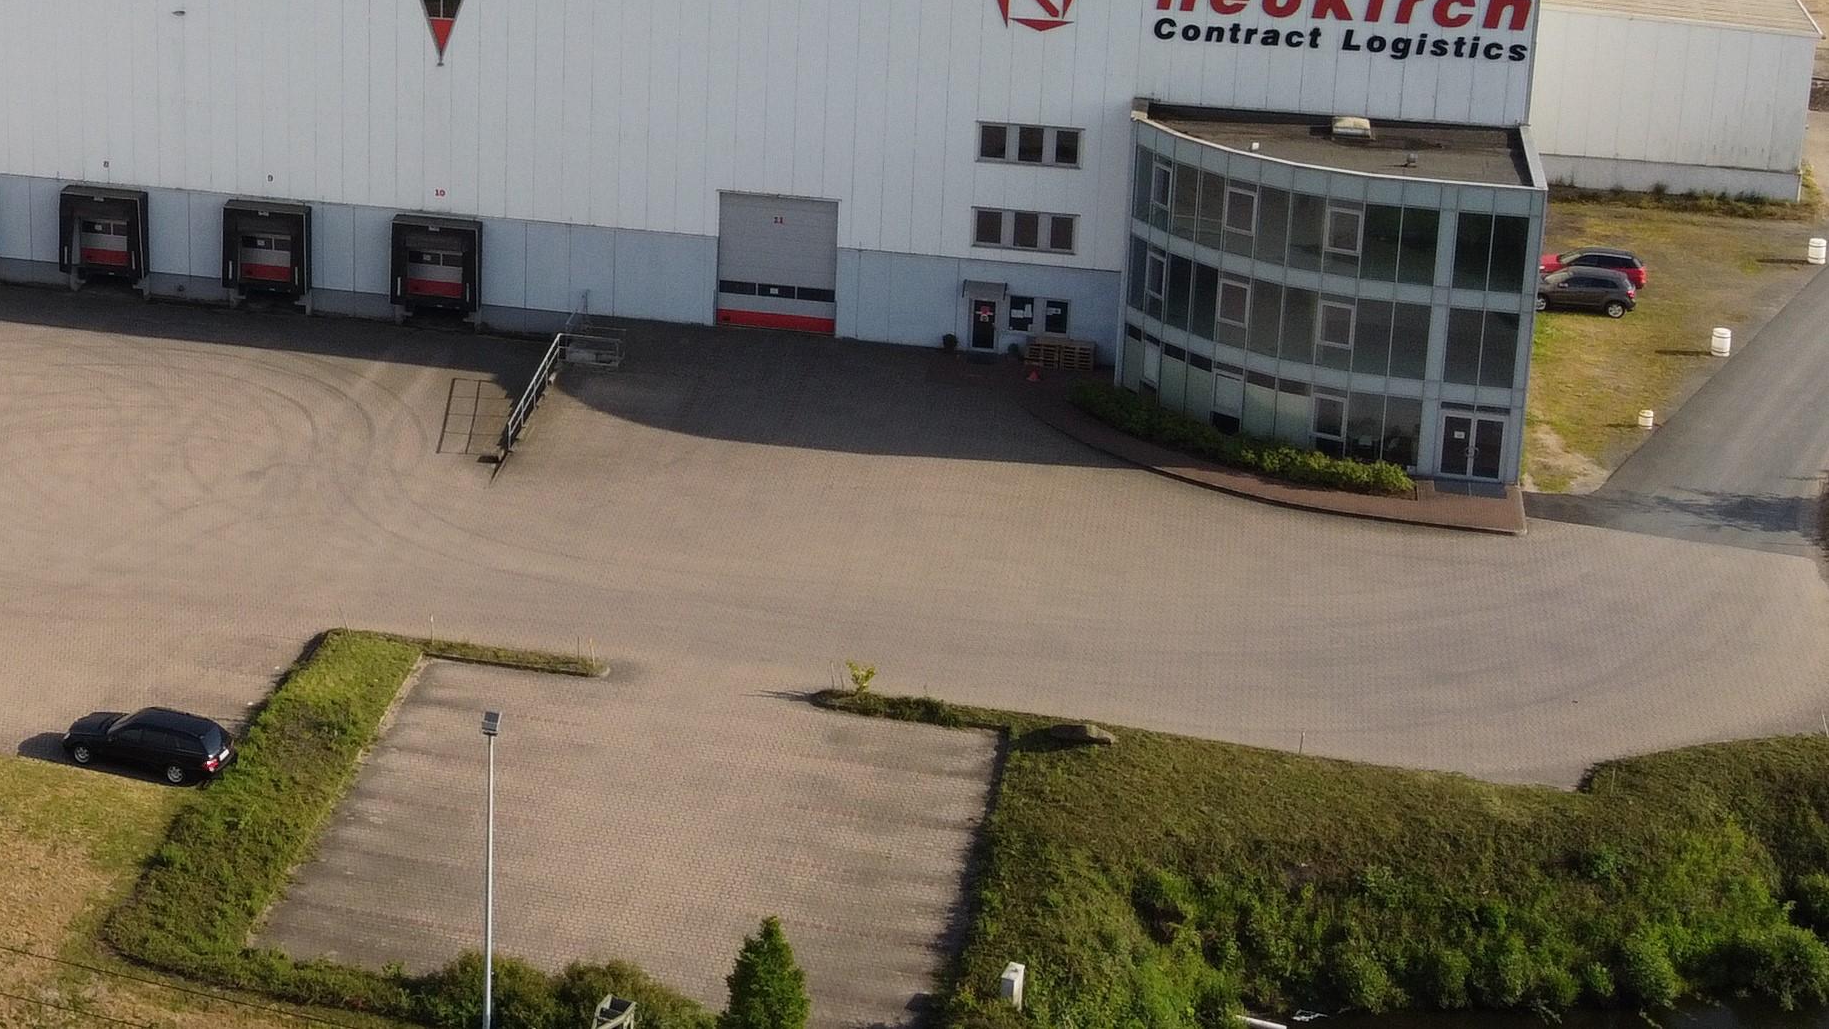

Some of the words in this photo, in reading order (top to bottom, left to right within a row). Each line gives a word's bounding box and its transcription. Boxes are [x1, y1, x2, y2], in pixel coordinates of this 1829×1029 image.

[1154, 17, 1321, 49] Contract
[1342, 29, 1529, 62] Logistics
[435, 189, 446, 197] 10
